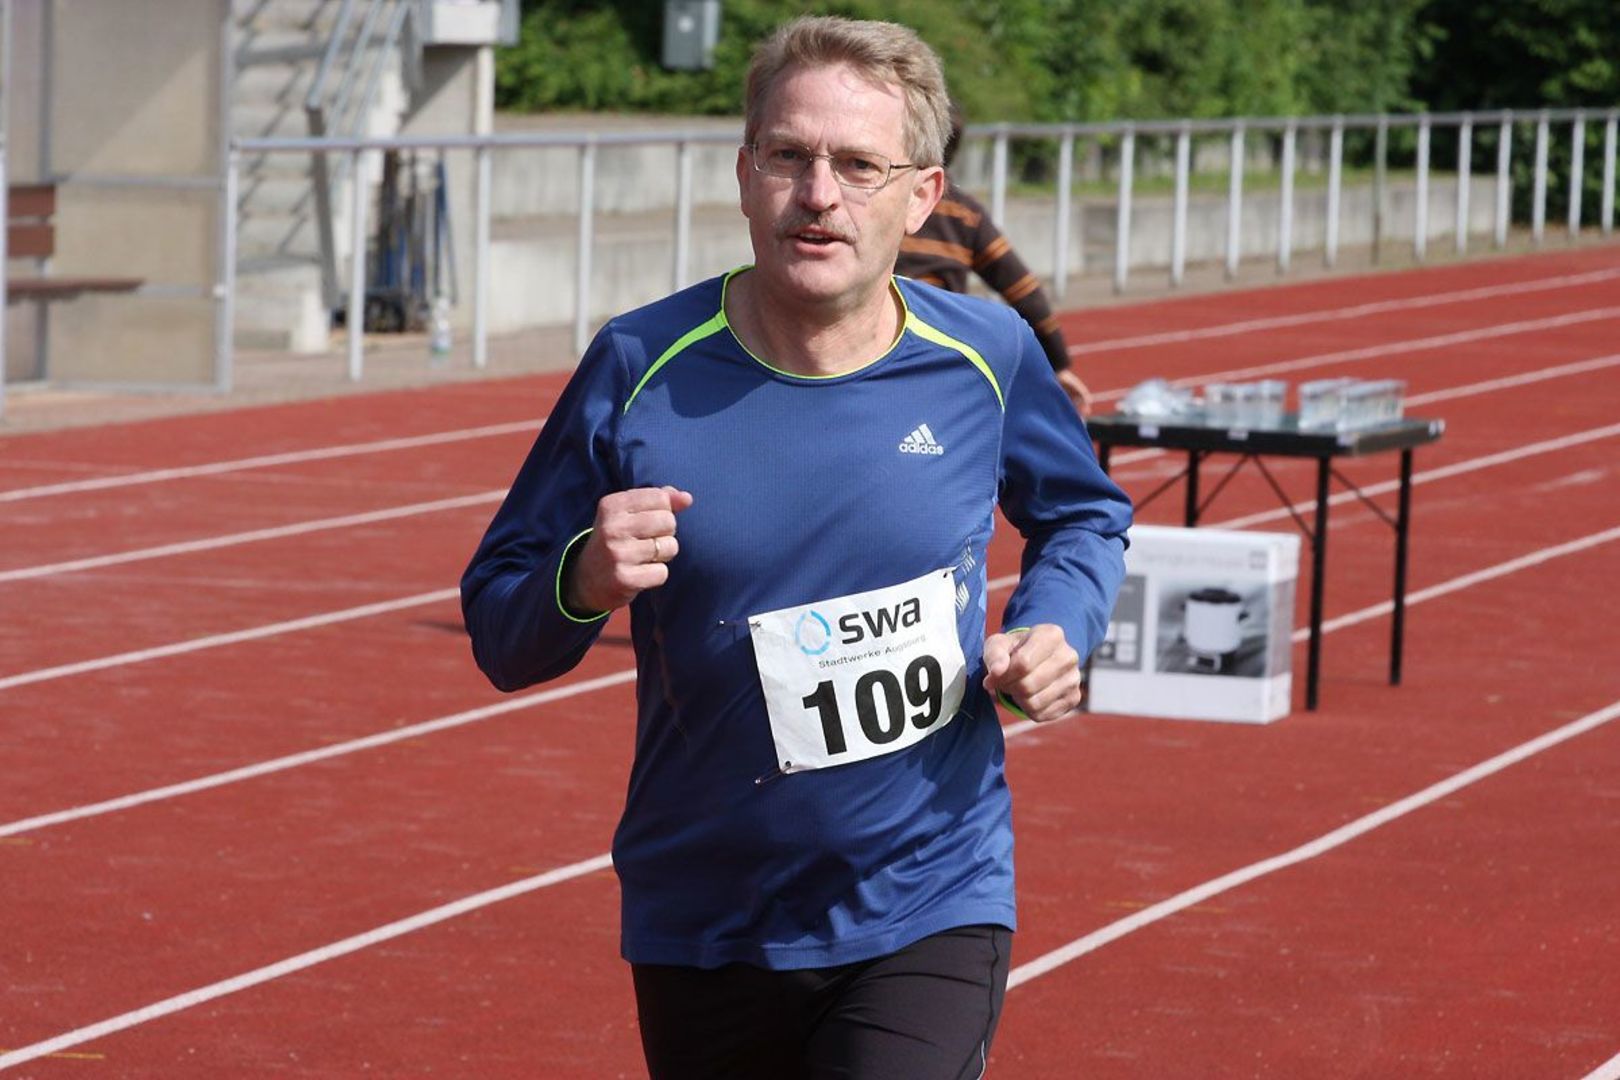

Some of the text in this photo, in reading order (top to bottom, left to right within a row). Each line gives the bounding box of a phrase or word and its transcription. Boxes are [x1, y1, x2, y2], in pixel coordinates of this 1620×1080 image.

[899, 441, 944, 455] adidas
[838, 597, 921, 644] swa
[818, 650, 881, 668] Stadtwerke
[802, 655, 943, 755] 109
